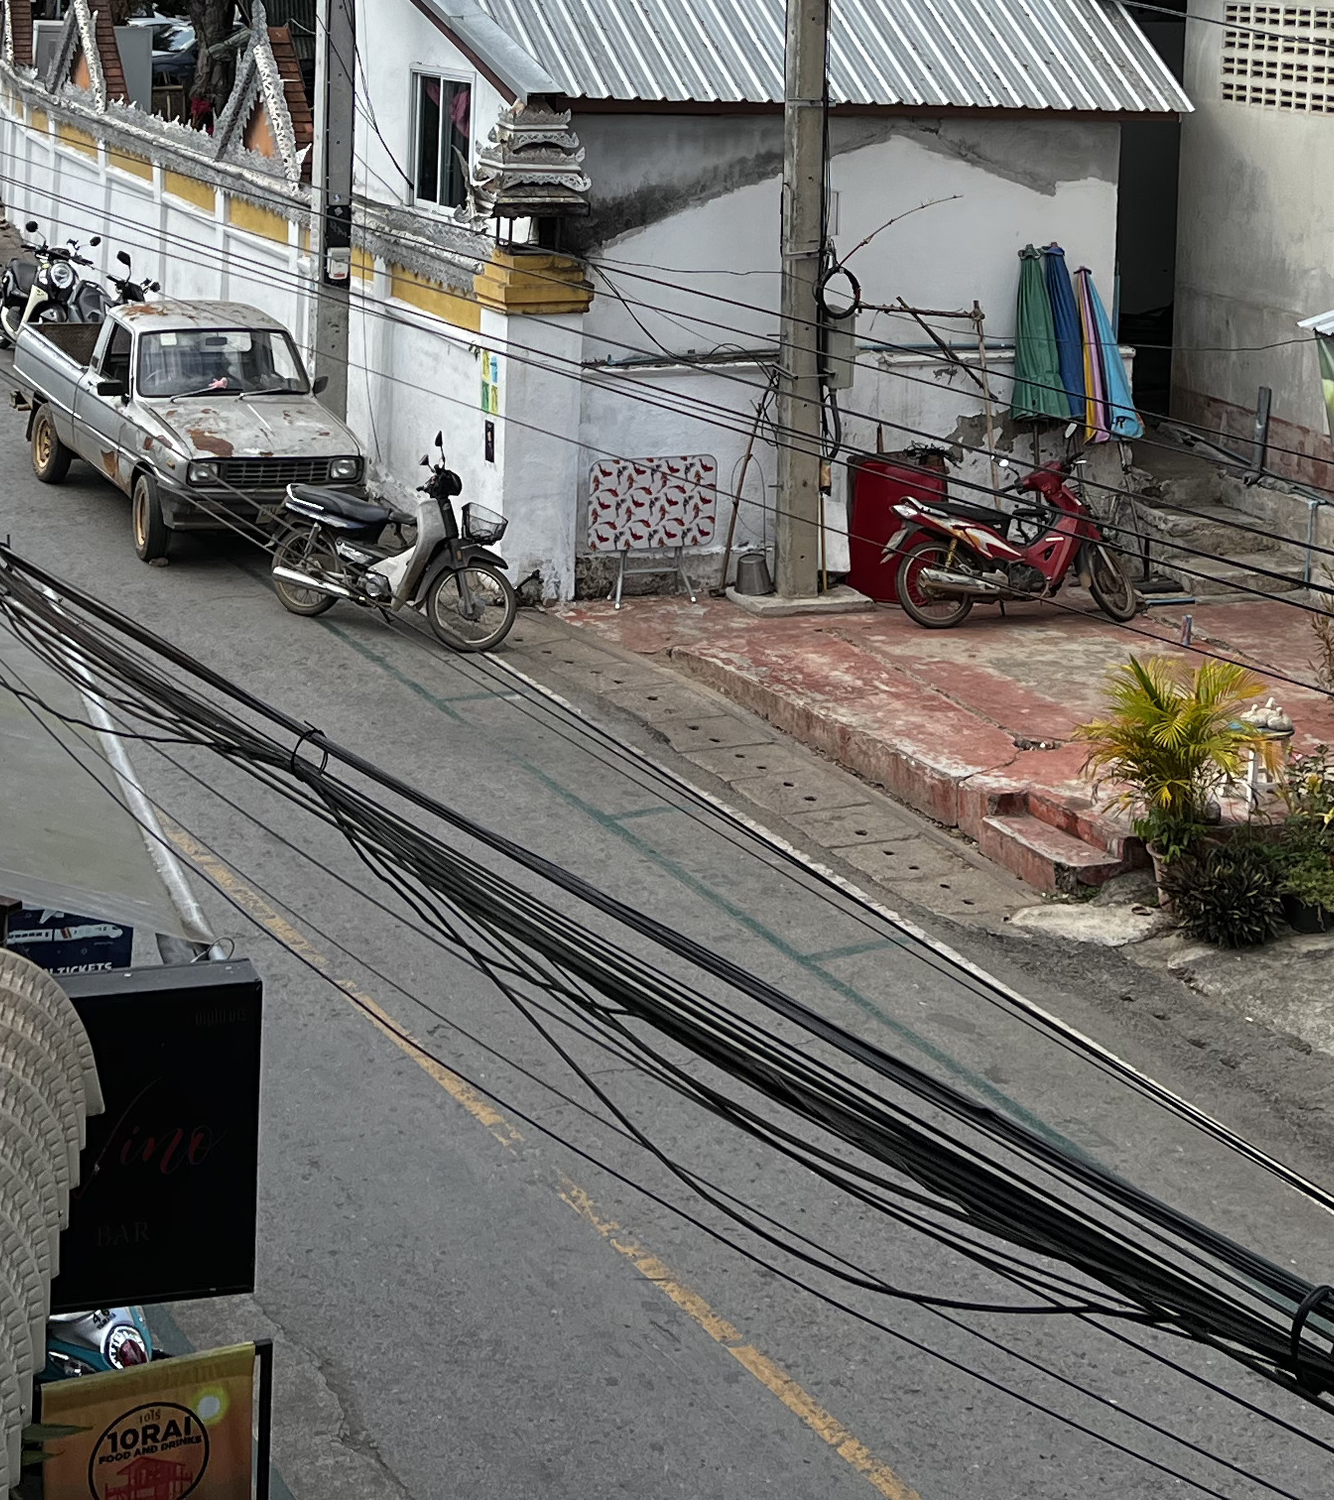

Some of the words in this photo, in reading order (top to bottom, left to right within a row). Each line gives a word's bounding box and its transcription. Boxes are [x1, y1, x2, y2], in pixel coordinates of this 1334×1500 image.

[95, 1220, 152, 1248] BAR
[107, 1416, 191, 1453] 10RAI
[98, 1451, 131, 1465] FOOD
[133, 1445, 158, 1458] AND
[161, 1435, 202, 1451] DRINKS
